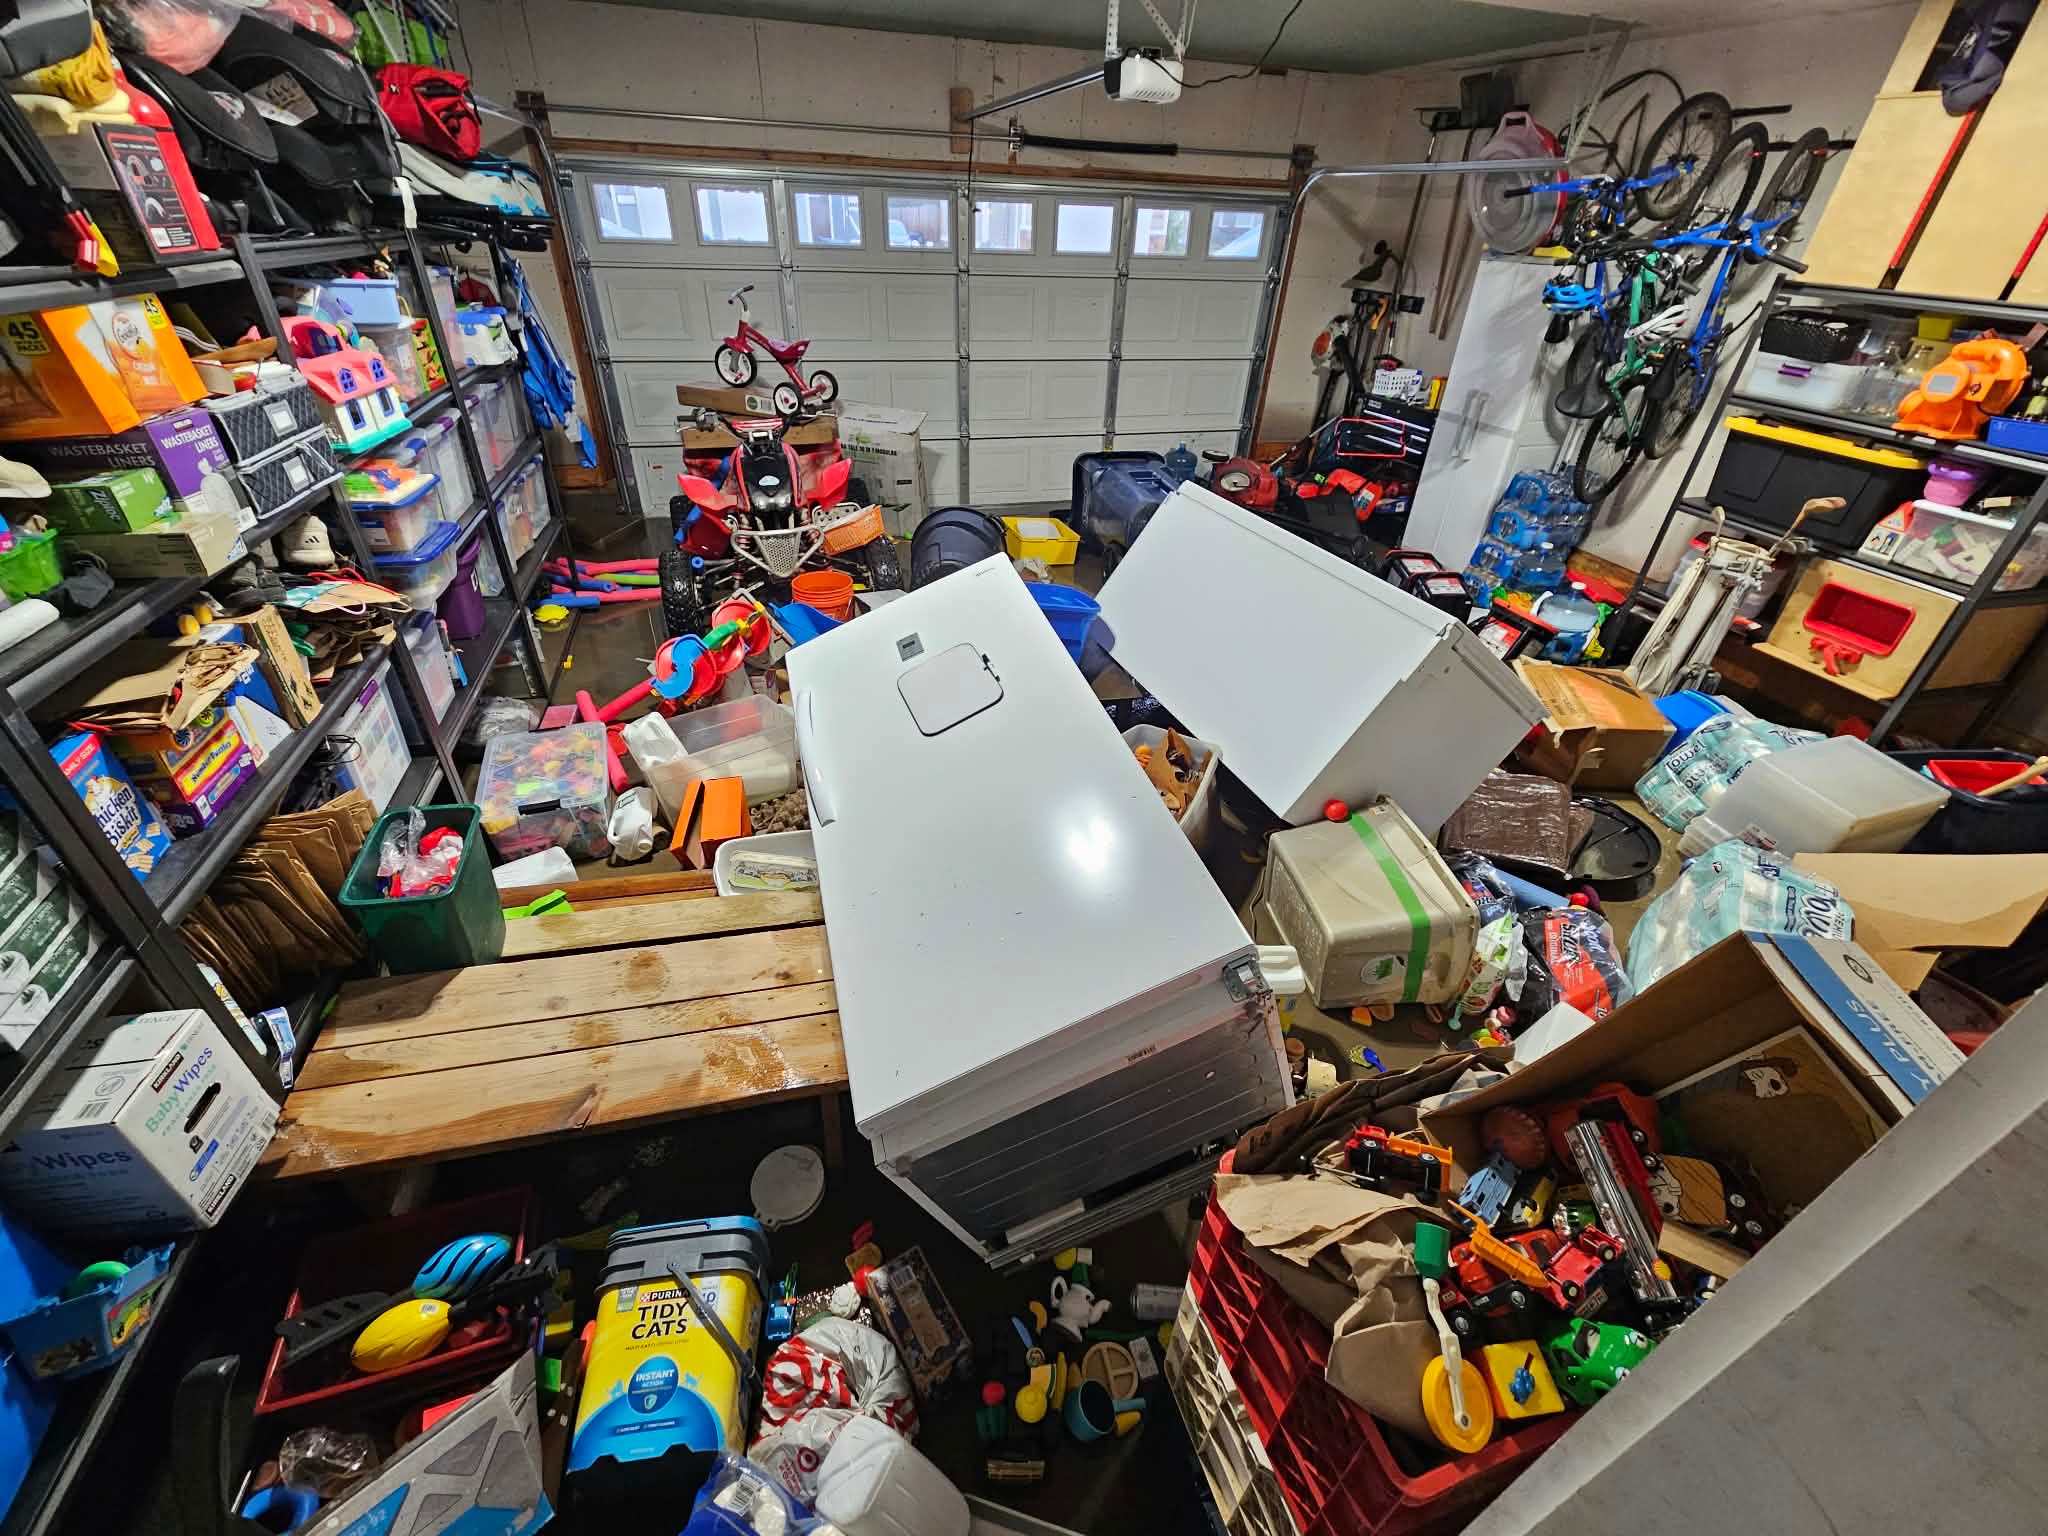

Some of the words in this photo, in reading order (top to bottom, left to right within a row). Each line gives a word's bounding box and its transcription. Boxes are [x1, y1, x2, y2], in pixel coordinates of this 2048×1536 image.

[8, 320, 40, 340] 45
[161, 424, 213, 449] WASTEBASKET
[194, 437, 219, 454] LINERS
[51, 443, 148, 457] WASTEBASKET
[108, 455, 156, 468] LINERS
[1846, 999, 1912, 1063] PLUS
[145, 1093, 182, 1133] Baby
[174, 1047, 213, 1093] Wipes
[31, 1151, 132, 1169] Wipes
[638, 1300, 690, 1321] TIDY
[631, 1319, 688, 1340] CATS
[635, 1369, 675, 1383] INSTANT
